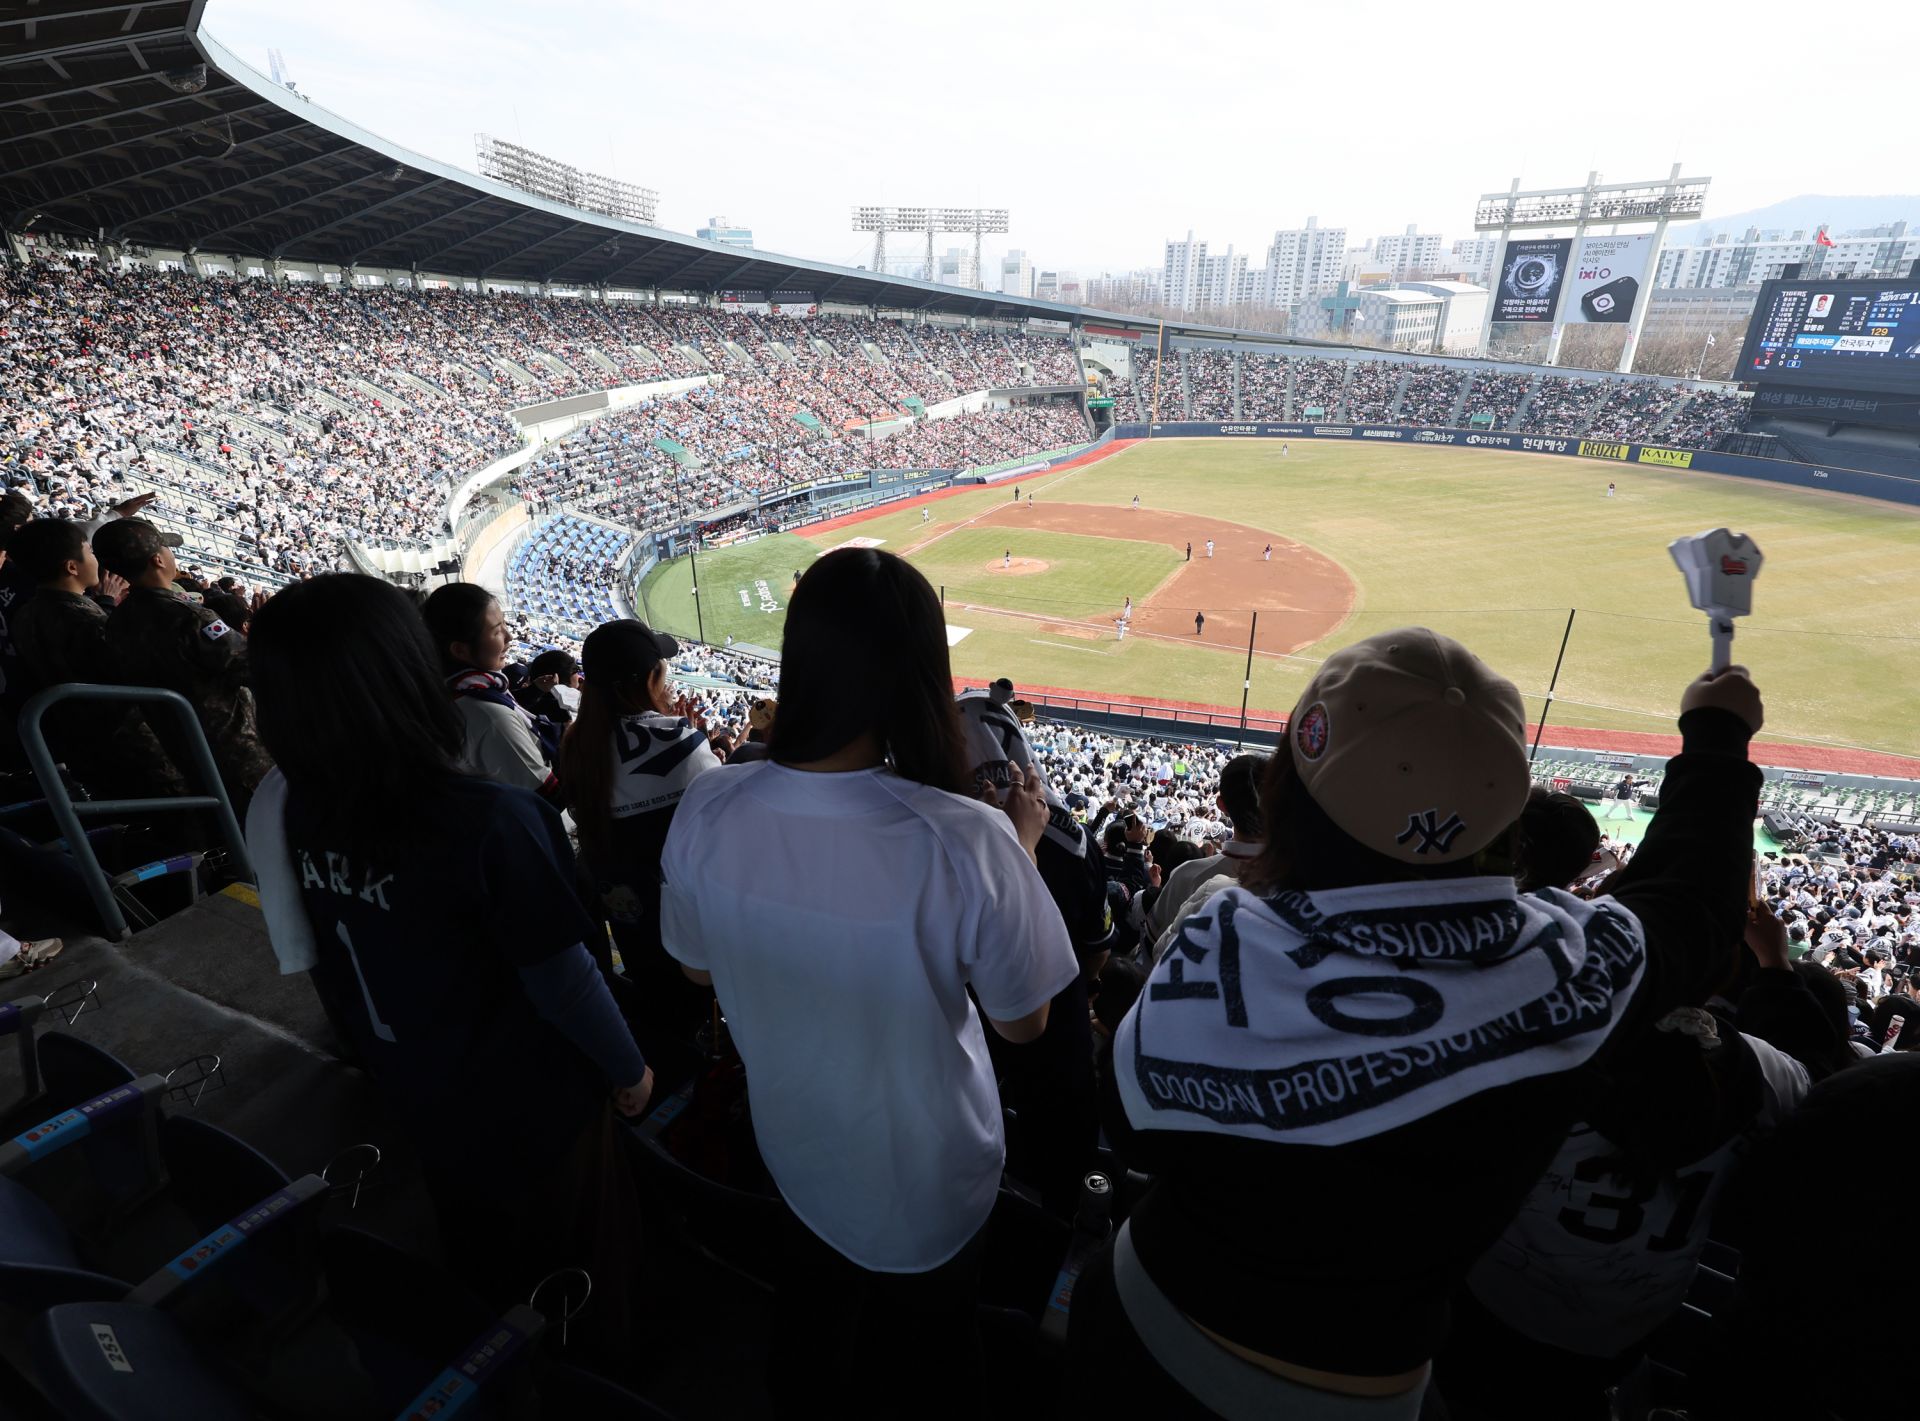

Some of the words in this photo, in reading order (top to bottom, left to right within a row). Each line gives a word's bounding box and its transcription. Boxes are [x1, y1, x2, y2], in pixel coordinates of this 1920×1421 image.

[1586, 241, 1615, 249] 보이스피싱
[1592, 249, 1615, 257] 에이전트
[1582, 256, 1600, 264] 익시오
[1782, 290, 1808, 298] TIGERS
[1503, 298, 1526, 306] 걱정하는
[1526, 298, 1550, 306] 마음까지
[1871, 327, 1888, 336] 129
[1840, 339, 1874, 348] 한국투자
[1760, 391, 1783, 404] 여성
[1816, 396, 1841, 409] 리딩
[1841, 398, 1880, 413] 파트너
[1480, 435, 1510, 446] 금강주택
[1522, 437, 1567, 452] 현대해상
[1582, 441, 1622, 459] REUZEL
[1641, 448, 1690, 462] KAIVE
[1813, 470, 1828, 478] 125m
[1394, 807, 1466, 855] NY
[1148, 1069, 1264, 1117] DOOSAN
[1270, 1007, 1541, 1117] PROFESSIONAL
[97, 1332, 125, 1363] 253
